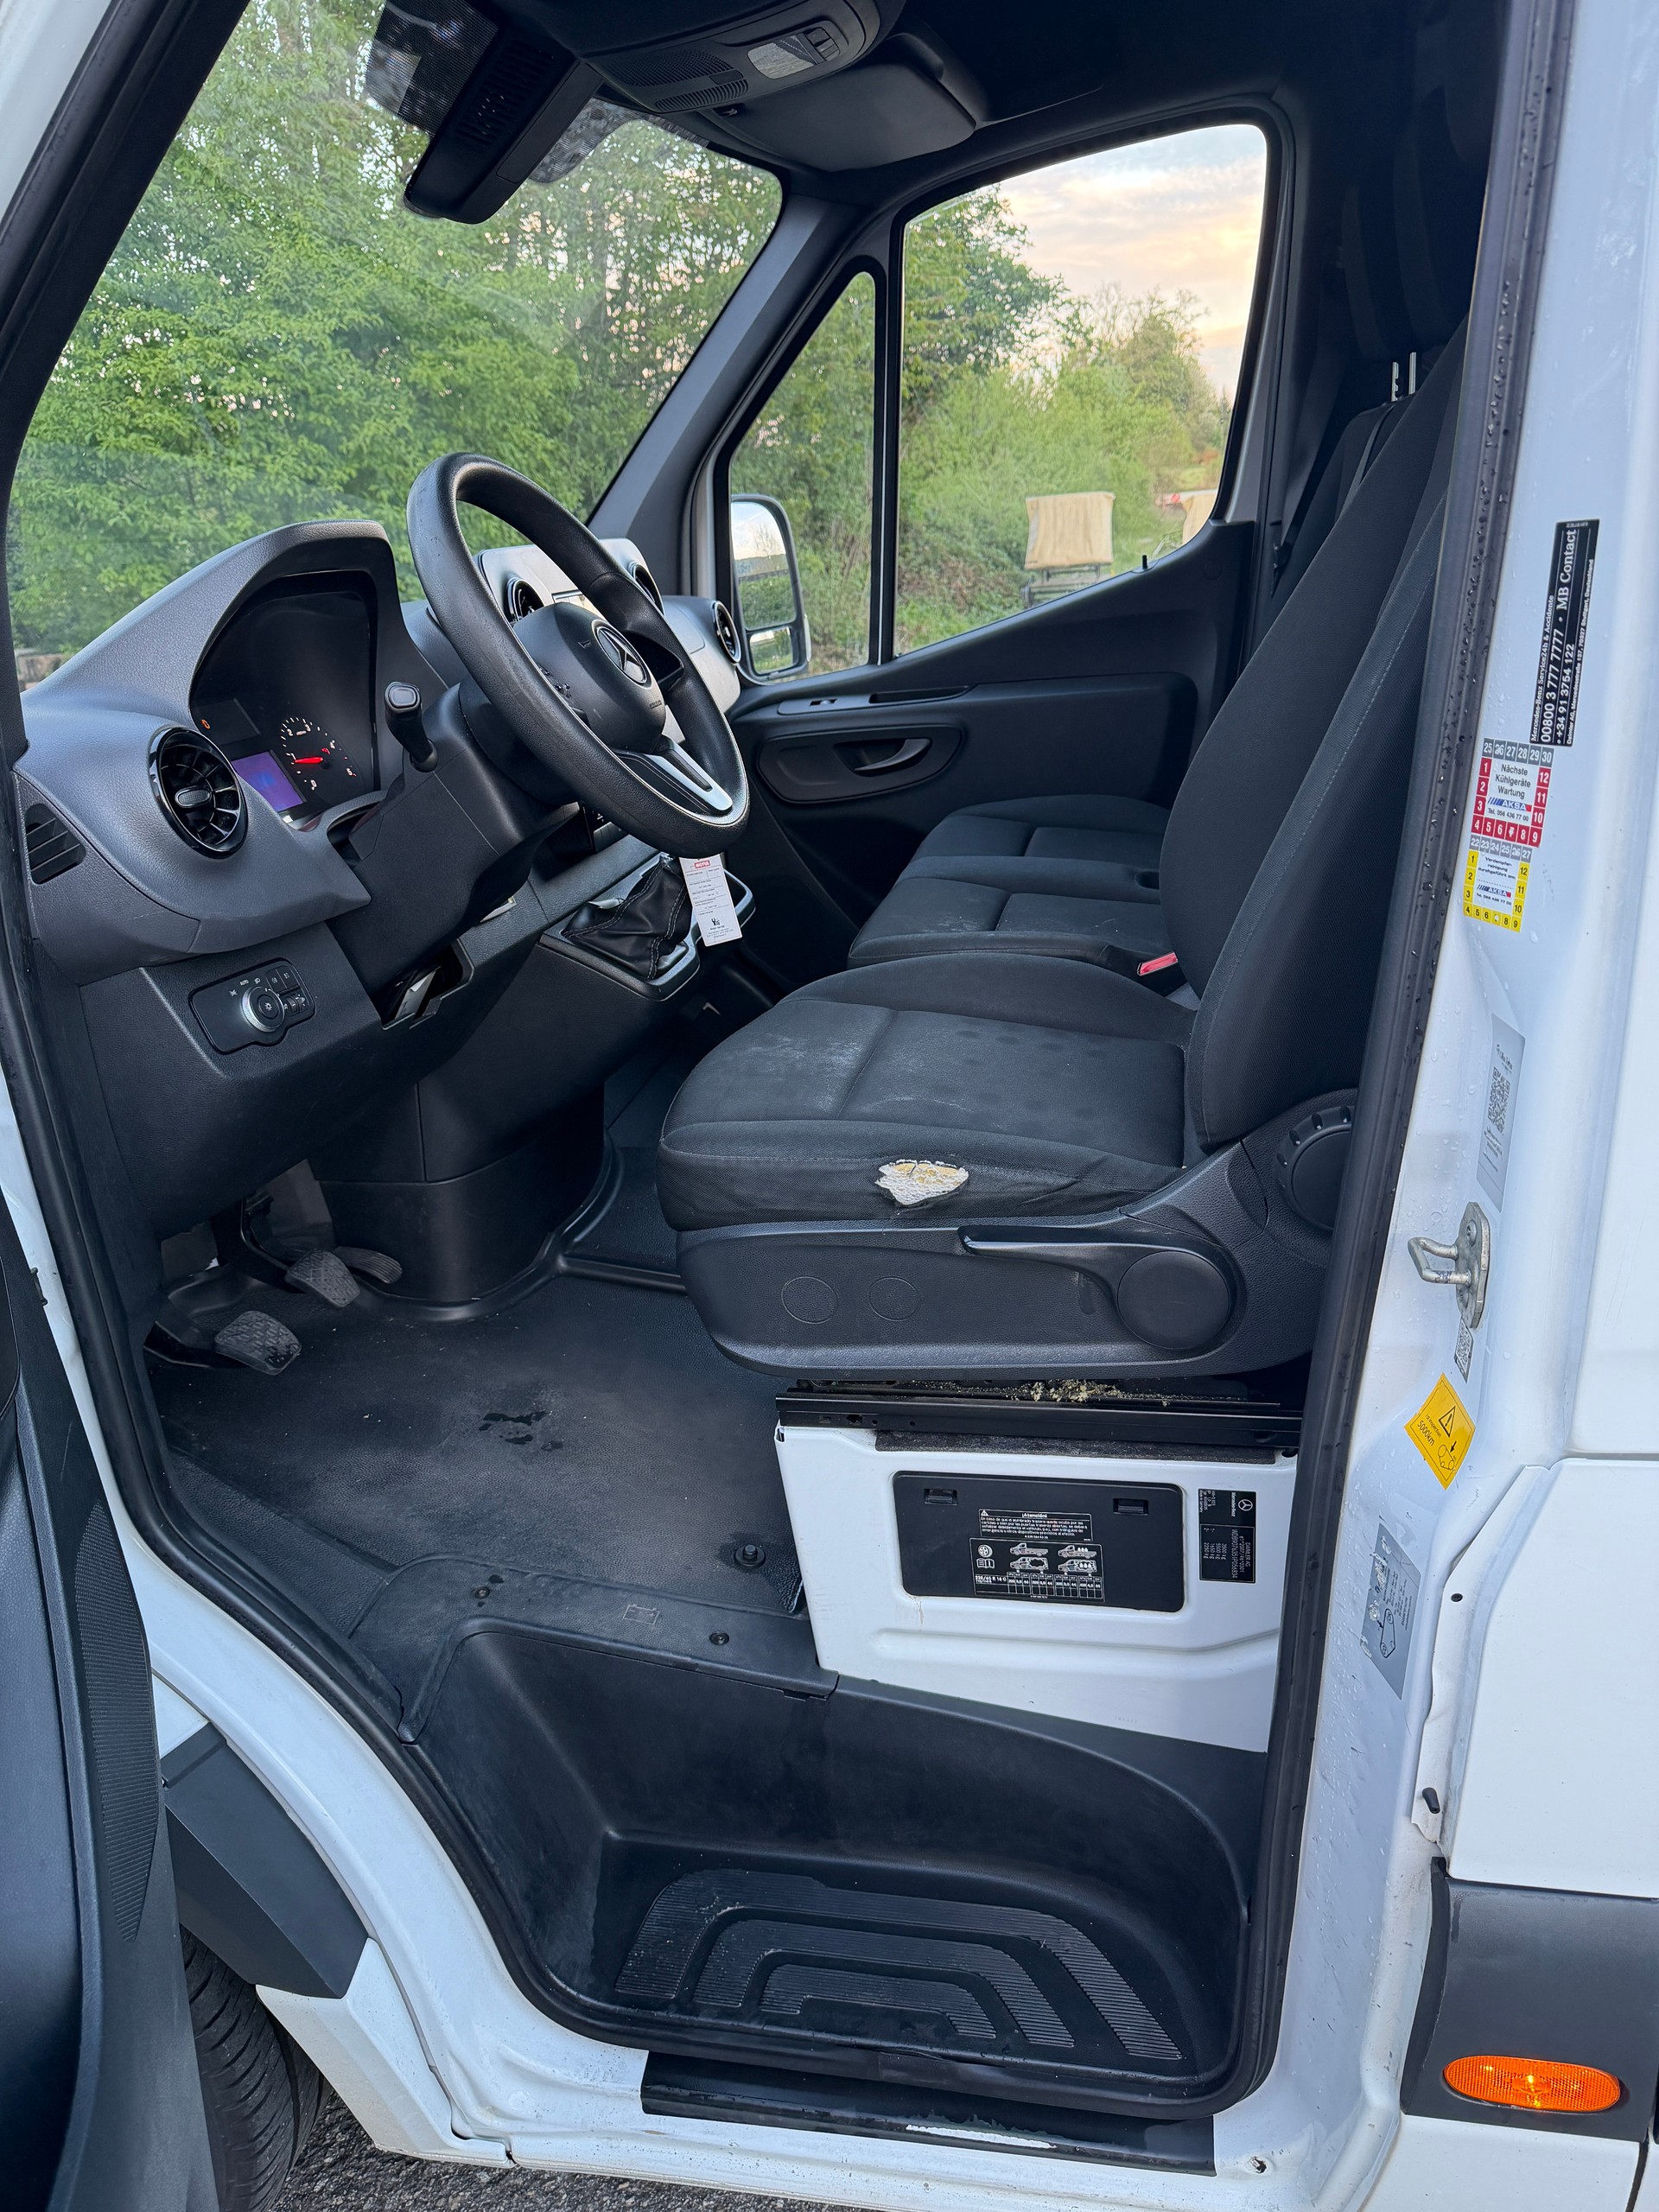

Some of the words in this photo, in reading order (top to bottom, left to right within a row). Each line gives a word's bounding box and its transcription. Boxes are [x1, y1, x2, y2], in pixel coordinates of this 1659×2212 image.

[1560, 529, 1576, 583] Contact
[1585, 559, 1594, 597] Deutschland
[1556, 586, 1569, 611] MB
[1551, 628, 1564, 661] 7777
[1565, 644, 1574, 664] 122
[1531, 686, 1542, 741] Mercedes-Benz
[1538, 642, 1548, 684] Service24h
[1544, 594, 1554, 633] Accidente
[1548, 664, 1560, 689] 777
[1560, 667, 1571, 696] 3754
[1546, 691, 1556, 700] 3
[1559, 700, 1567, 714] 91
[1541, 702, 1554, 742] 00800
[1556, 716, 1566, 737] +34
[1484, 742, 1492, 754] 25
[1495, 744, 1504, 755] 26
[1506, 747, 1516, 757] 27
[1518, 747, 1528, 759] 28
[1529, 749, 1540, 761] 29
[1541, 752, 1552, 763] 30
[1484, 762, 1488, 773] 1
[1501, 764, 1529, 776] Nächste
[1495, 774, 1531, 787] Kühlgeräte
[1539, 772, 1549, 784] 12
[1480, 781, 1486, 792] 2
[1497, 785, 1525, 800] Wartung
[1537, 792, 1546, 804] 11
[1477, 800, 1483, 811] 3
[1502, 800, 1527, 811] AKSA
[1534, 812, 1543, 823] 10
[1474, 819, 1480, 830] 4
[1486, 821, 1491, 832] 5
[1497, 824, 1503, 835] 6
[1521, 830, 1526, 840] 8
[1532, 832, 1538, 842] 9
[1471, 838, 1479, 847] 22
[1481, 840, 1490, 849] 23
[1491, 842, 1499, 851] 24
[1501, 845, 1510, 855] 25
[1522, 849, 1530, 859] 27
[1487, 864, 1508, 873] reinigung
[1520, 867, 1528, 876] 12
[1517, 886, 1525, 894] 11
[1514, 905, 1522, 913] 10
[1417, 1420, 1435, 1446] 5000km
